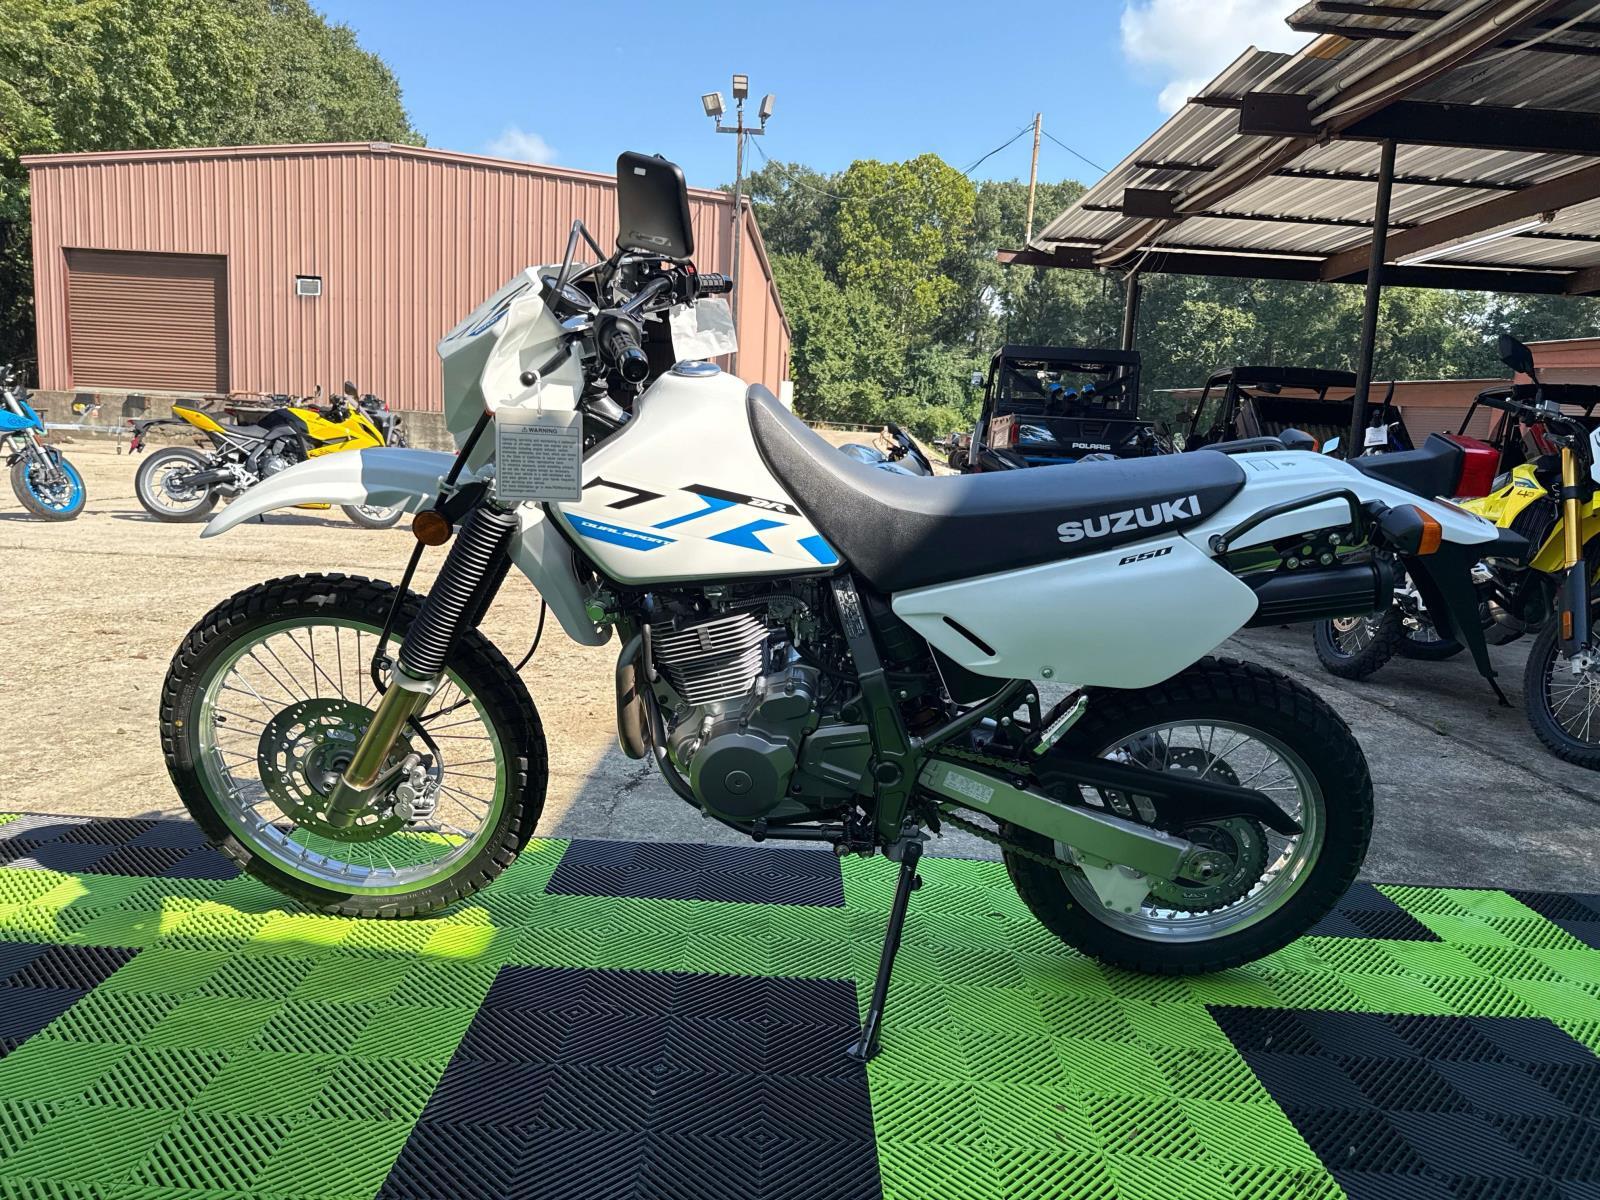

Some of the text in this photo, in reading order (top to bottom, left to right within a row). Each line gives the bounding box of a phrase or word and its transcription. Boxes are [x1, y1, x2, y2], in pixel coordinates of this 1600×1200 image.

[1072, 442, 1111, 450] POLARIS
[1056, 494, 1202, 543] SUZUKI
[1118, 546, 1175, 566] 650
